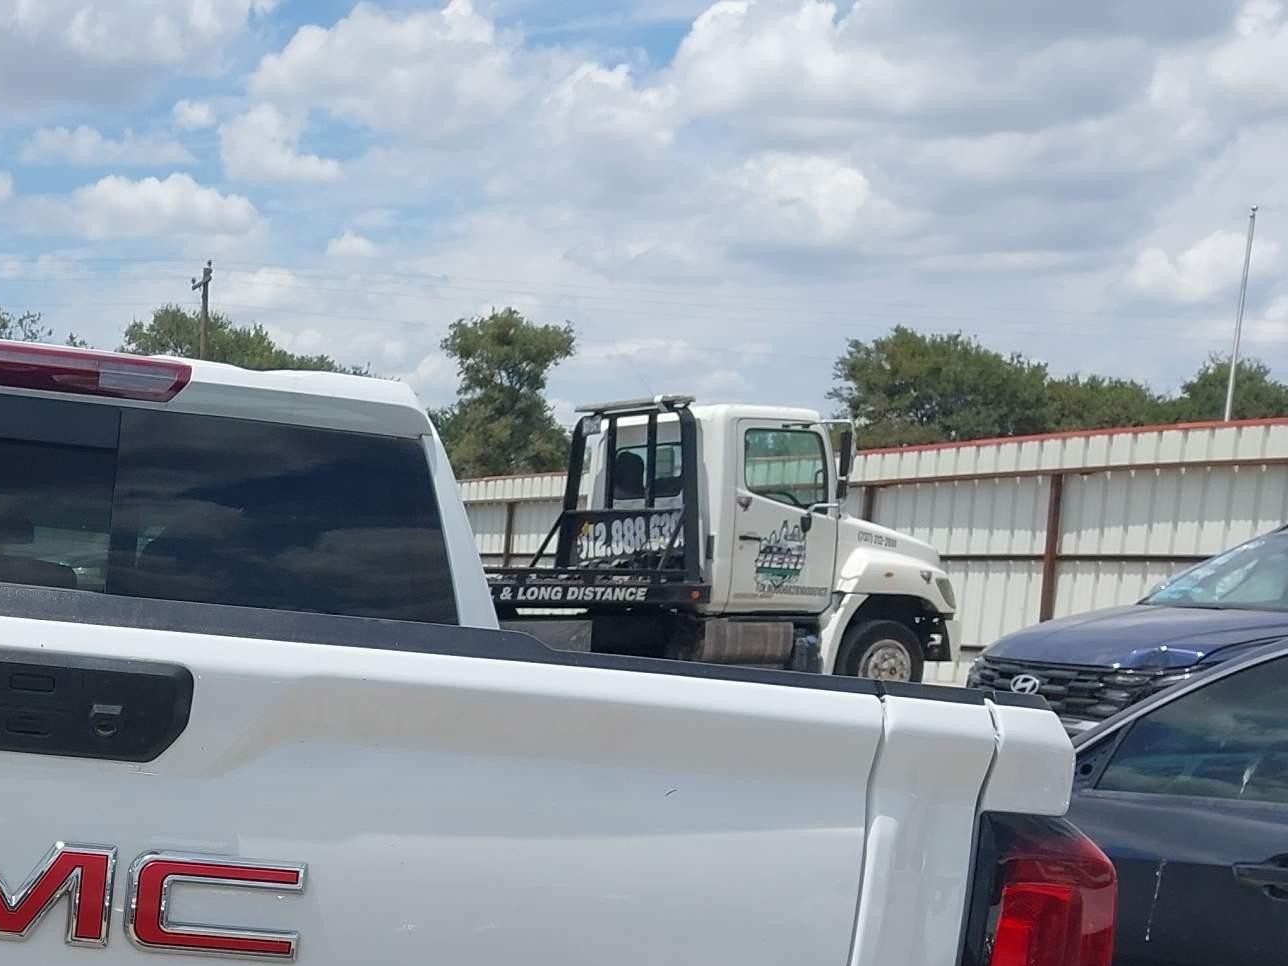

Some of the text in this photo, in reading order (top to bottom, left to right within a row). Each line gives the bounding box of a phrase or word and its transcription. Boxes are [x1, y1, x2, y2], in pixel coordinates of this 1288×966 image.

[499, 586, 513, 600] &
[516, 586, 563, 600] LONG
[566, 586, 648, 601] DISTANCE
